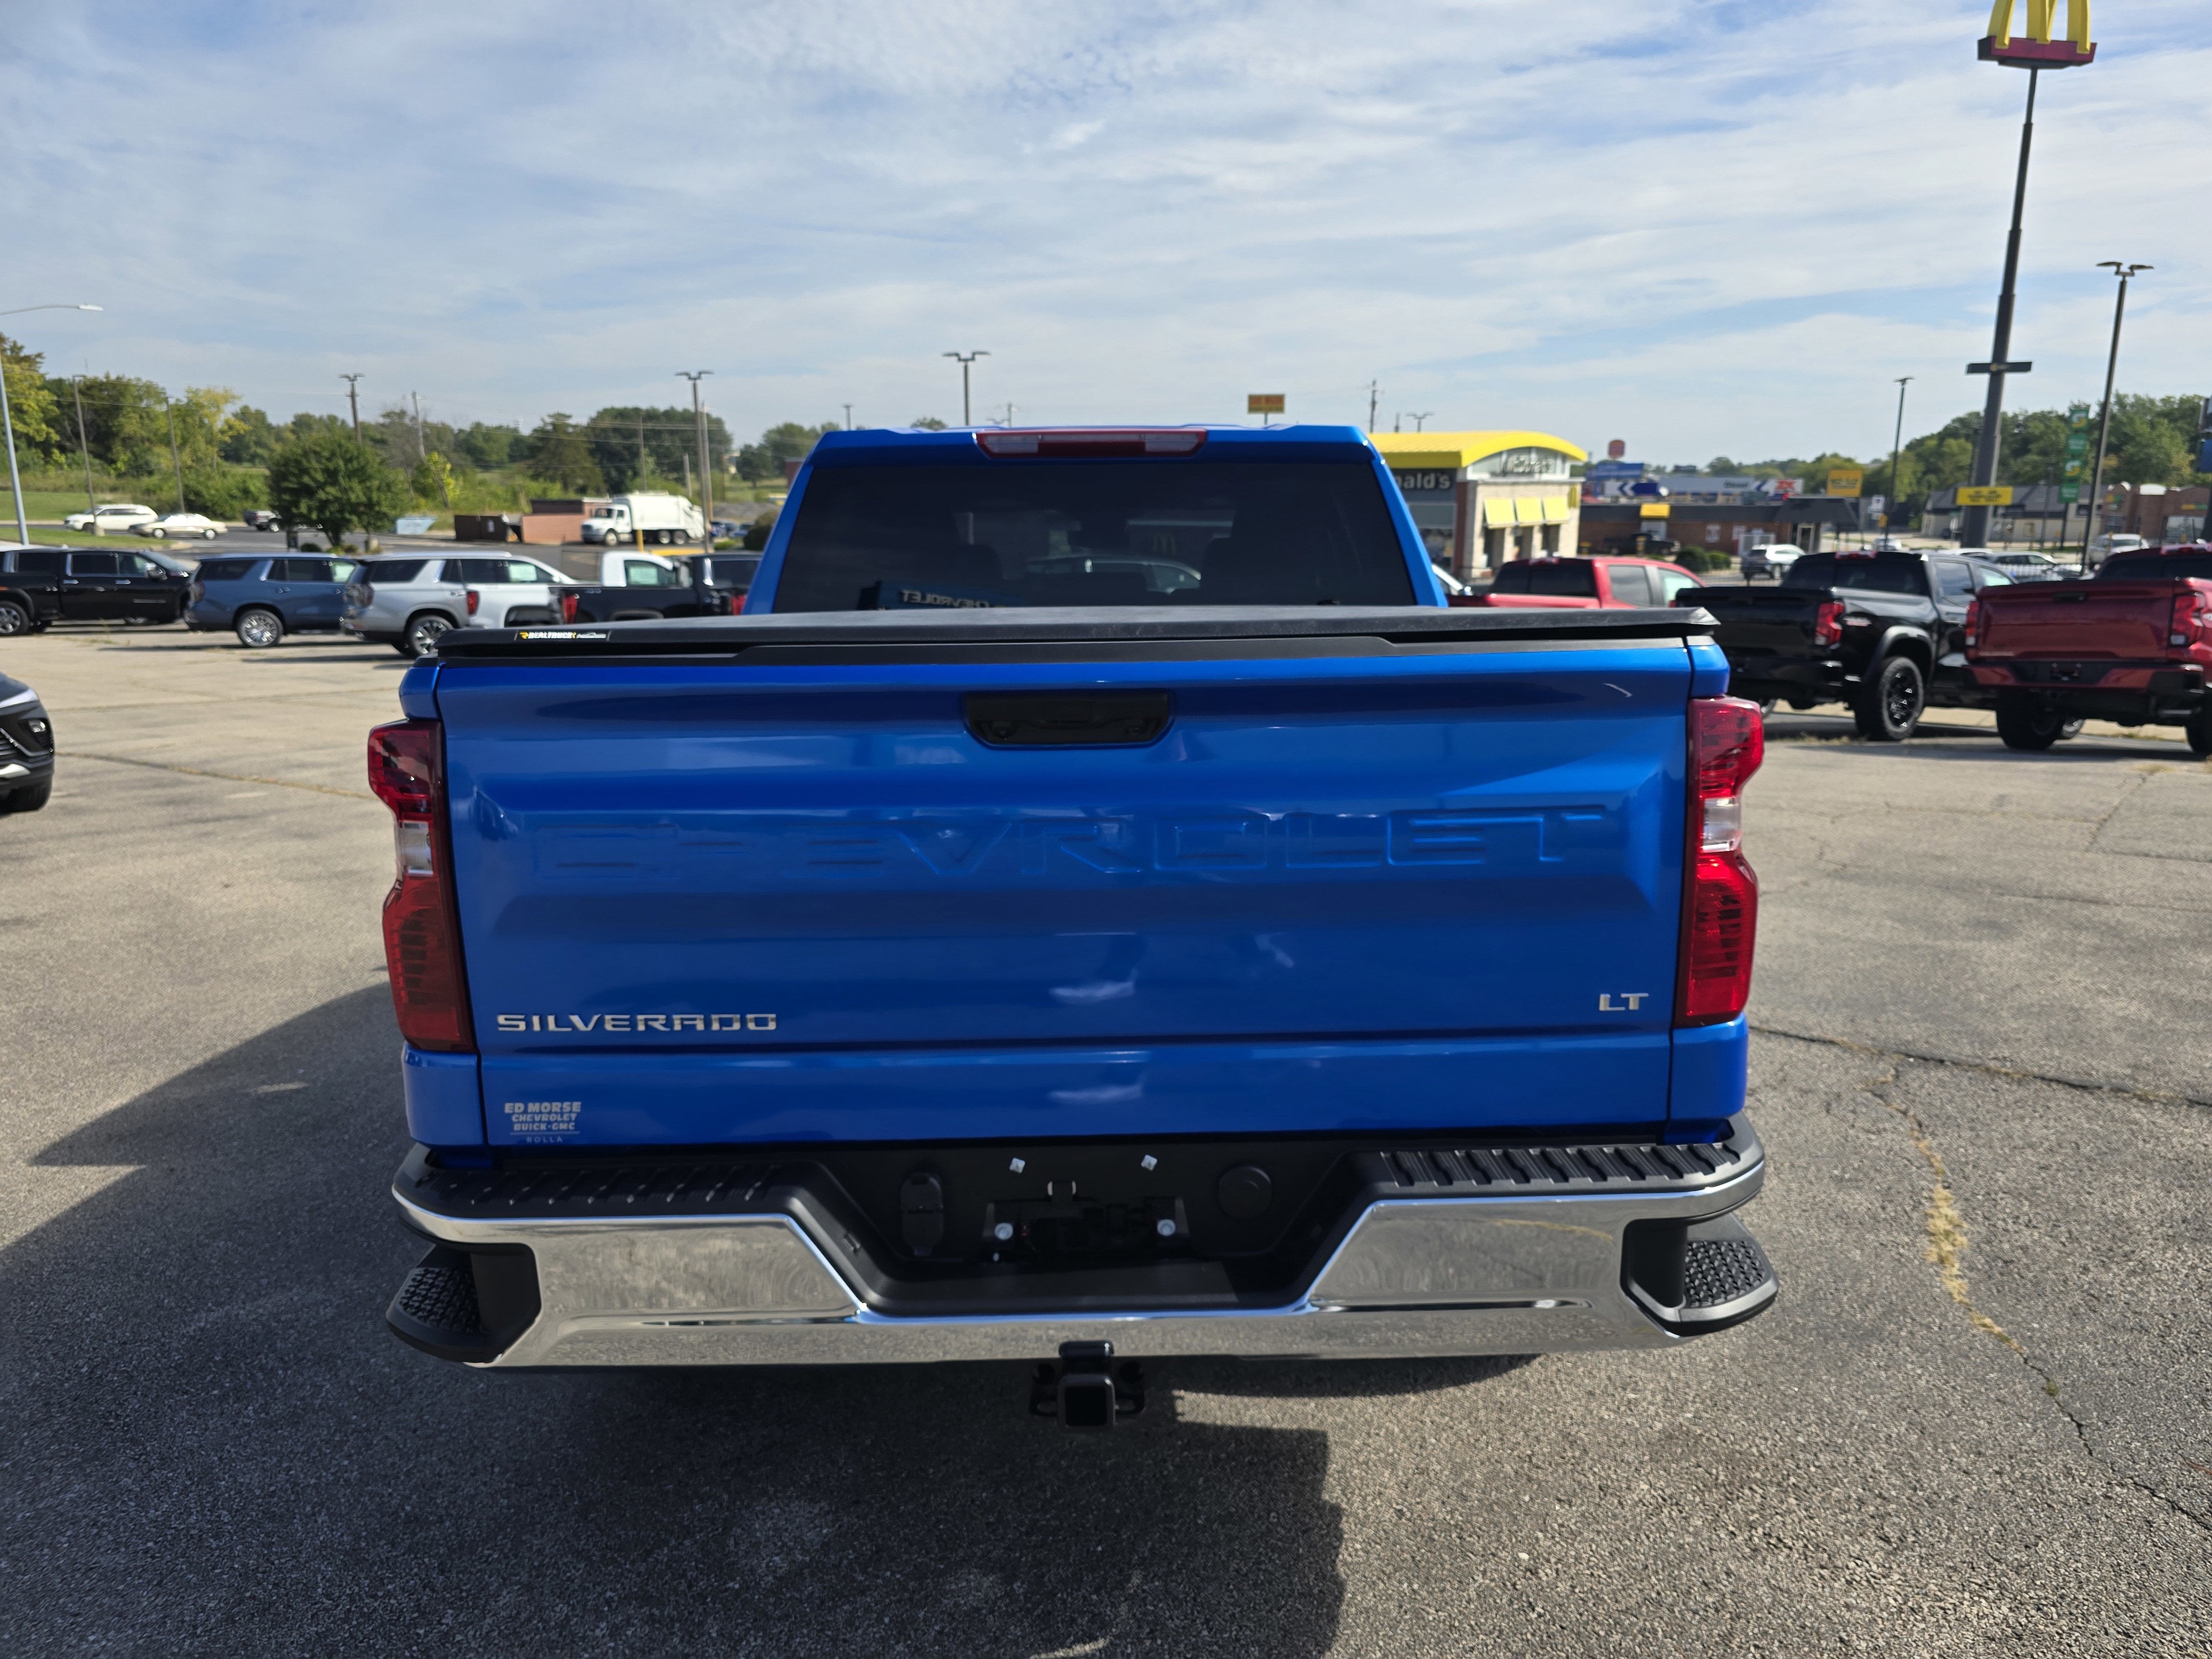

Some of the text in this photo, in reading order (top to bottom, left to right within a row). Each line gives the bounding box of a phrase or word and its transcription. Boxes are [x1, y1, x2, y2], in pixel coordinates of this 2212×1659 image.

[1599, 993, 1650, 1011] LT
[497, 1014, 777, 1032] SILVERADO
[504, 1102, 582, 1114] ED MORSE
[512, 1113, 577, 1122] CHEVROLET
